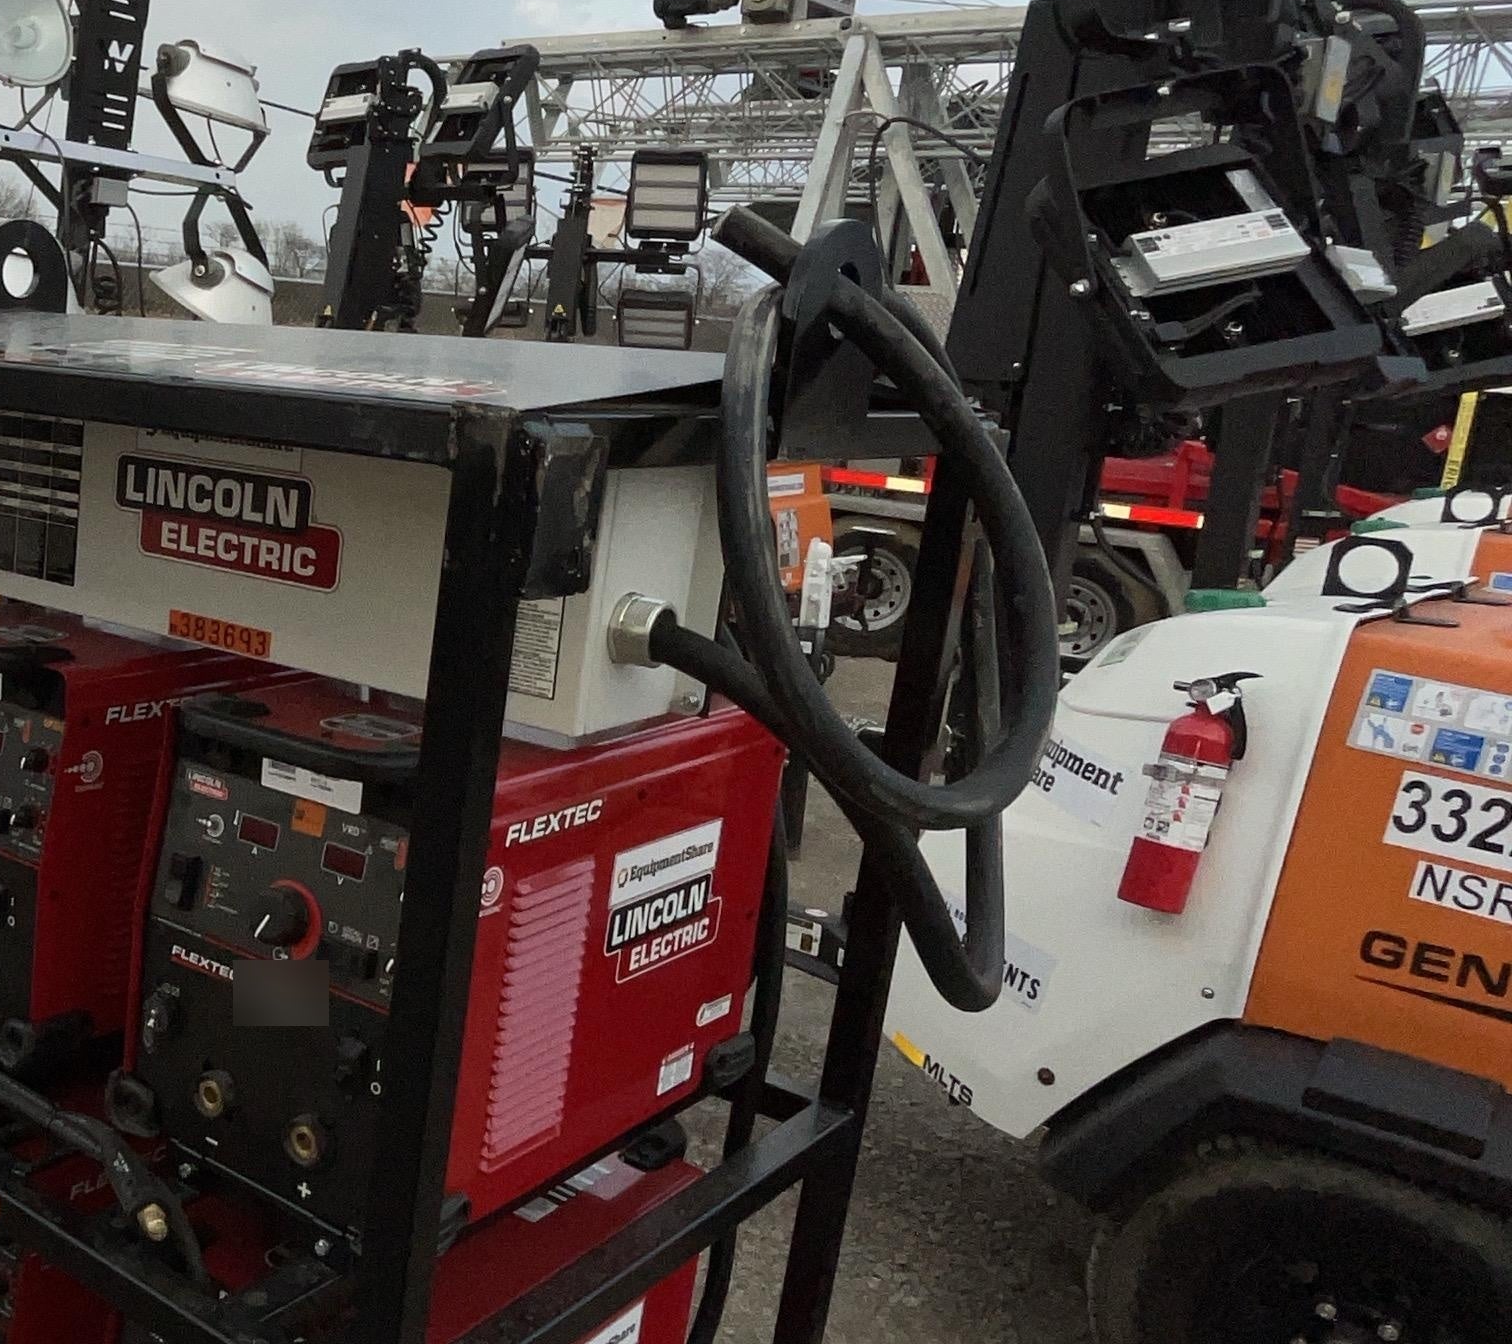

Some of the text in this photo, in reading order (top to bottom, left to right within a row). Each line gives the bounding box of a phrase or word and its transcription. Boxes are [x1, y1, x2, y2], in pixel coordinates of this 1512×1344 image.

[125, 464, 299, 529] LINCOLN
[160, 520, 317, 577] ELECTRIC
[178, 612, 267, 657] 383693
[505, 798, 604, 848] FLEXTEC
[1391, 779, 1512, 856] 332
[610, 880, 707, 947] LINCOLN
[628, 916, 710, 972] ELECTRIC
[1003, 958, 1041, 1001] NTS
[922, 1053, 974, 1107] MLTS
